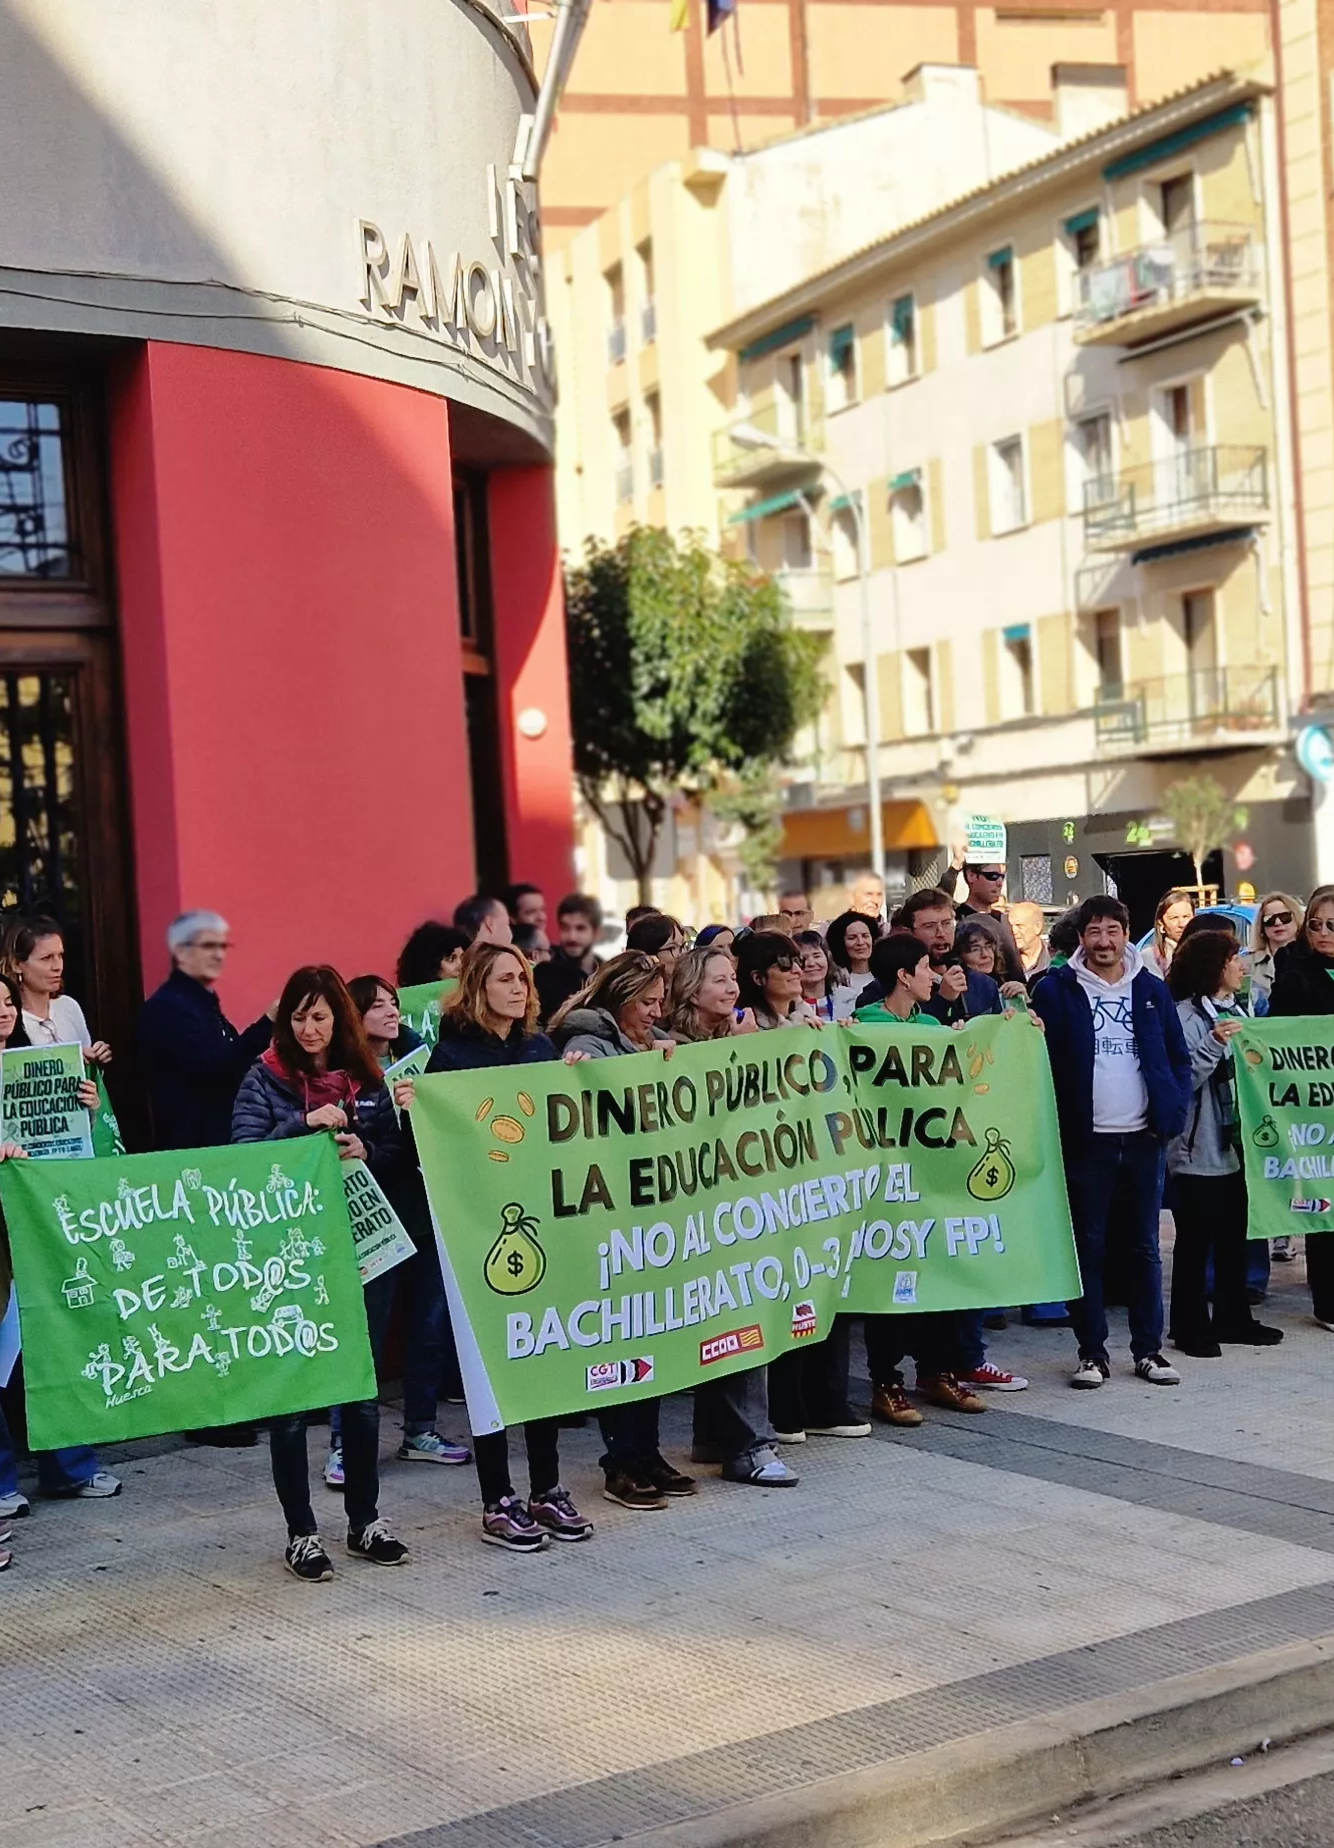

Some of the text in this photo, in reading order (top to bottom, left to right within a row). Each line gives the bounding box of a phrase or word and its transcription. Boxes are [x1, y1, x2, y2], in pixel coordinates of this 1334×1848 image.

[23, 1058, 64, 1079] DINERO
[53, 1076, 82, 1095] PARA
[546, 1044, 965, 1144] DINERO PÚBLICO, PARA
[1269, 1081, 1301, 1108] LA
[2, 1101, 18, 1120] LA
[1288, 1122, 1326, 1152] ¡NO
[551, 1163, 616, 1219] LA
[629, 1108, 819, 1208] EDUCACIÓN
[61, 1179, 196, 1245] ESCUELA
[201, 1177, 324, 1230] PÚBLICA:
[358, 1188, 382, 1212] EN
[598, 1222, 676, 1291] ¡NO
[682, 1210, 711, 1261] AL
[712, 1163, 881, 1247] CONCIERTO
[112, 1256, 312, 1321] DE TOD@S
[506, 1256, 791, 1360] BACHILLERATO,
[793, 1236, 841, 1290] 0-3
[944, 1213, 1006, 1258] FP!
[98, 1319, 339, 1396] PARA TOD@S
[701, 1334, 740, 1361] CCOO
[590, 1362, 616, 1377] CGT
